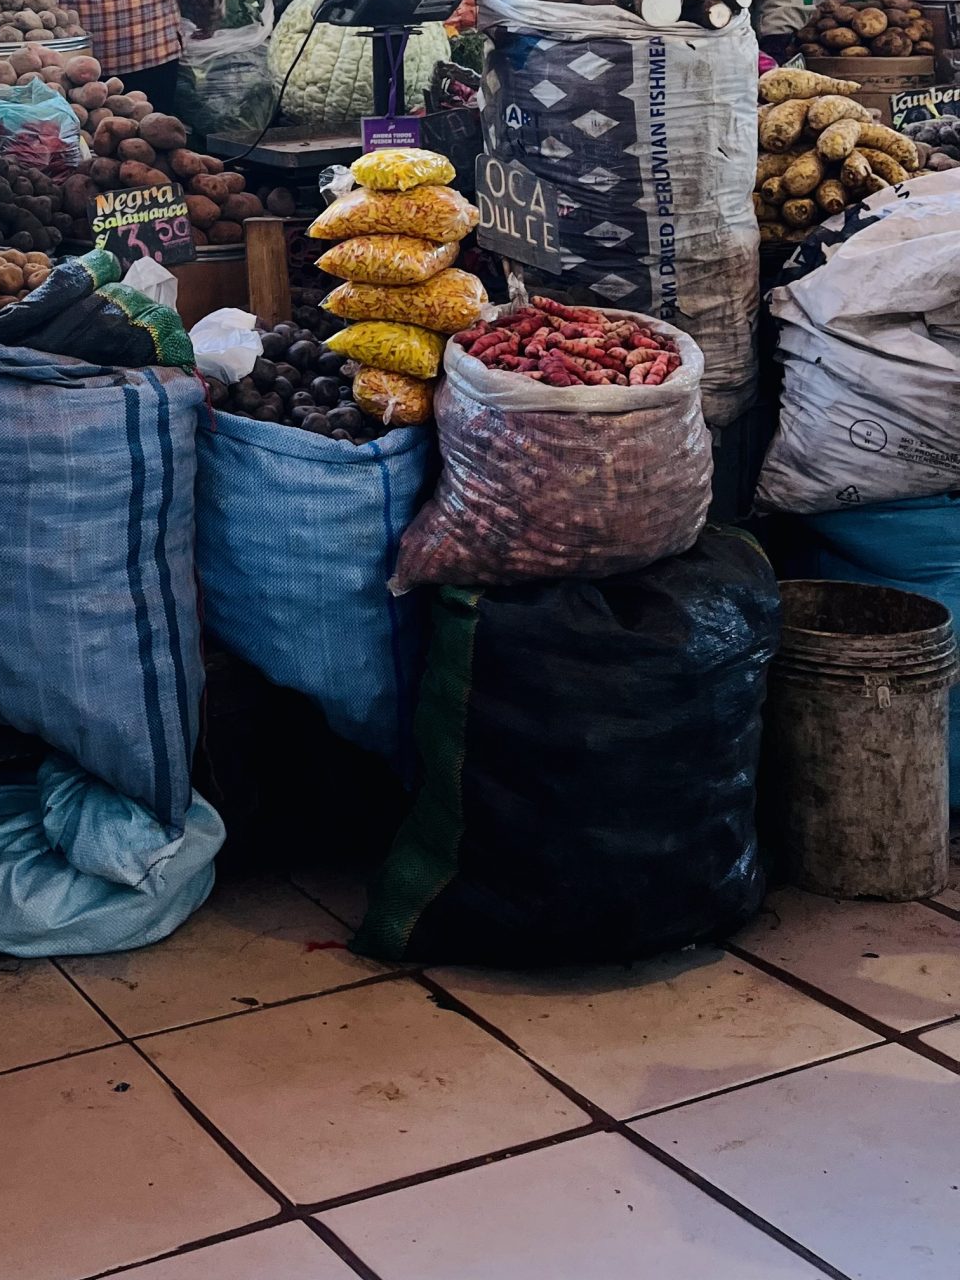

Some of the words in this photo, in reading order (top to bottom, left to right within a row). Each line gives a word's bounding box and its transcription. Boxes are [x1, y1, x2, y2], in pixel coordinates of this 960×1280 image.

[486, 161, 547, 217] OCA
[650, 122, 675, 217] PERUVIAN
[92, 202, 188, 233] Salamanca
[95, 185, 177, 216] Negra
[477, 191, 560, 253] DULCE
[660, 222, 676, 276] DRIED
